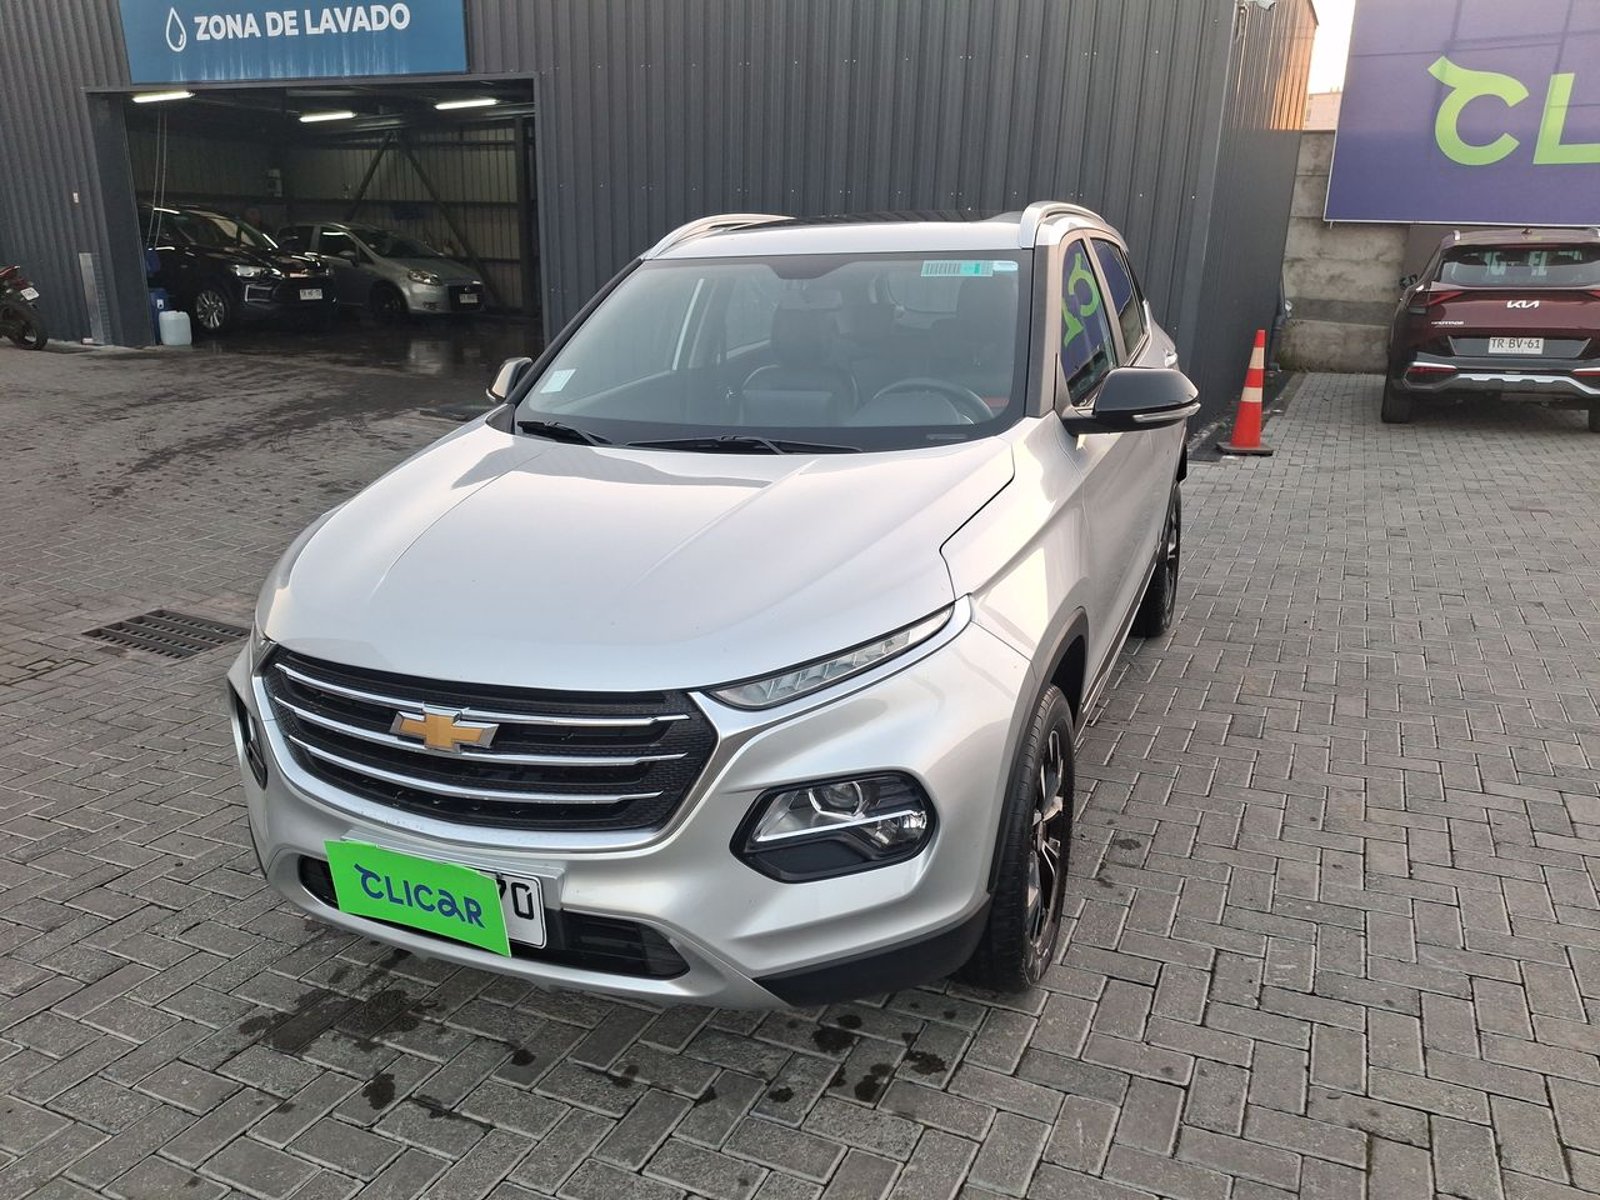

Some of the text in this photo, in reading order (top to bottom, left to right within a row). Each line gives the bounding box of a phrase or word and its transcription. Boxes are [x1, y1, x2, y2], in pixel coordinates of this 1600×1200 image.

[193, 2, 410, 40] ZONA DE LAVADO
[1427, 55, 1600, 166] CL
[1506, 300, 1540, 309] KIA
